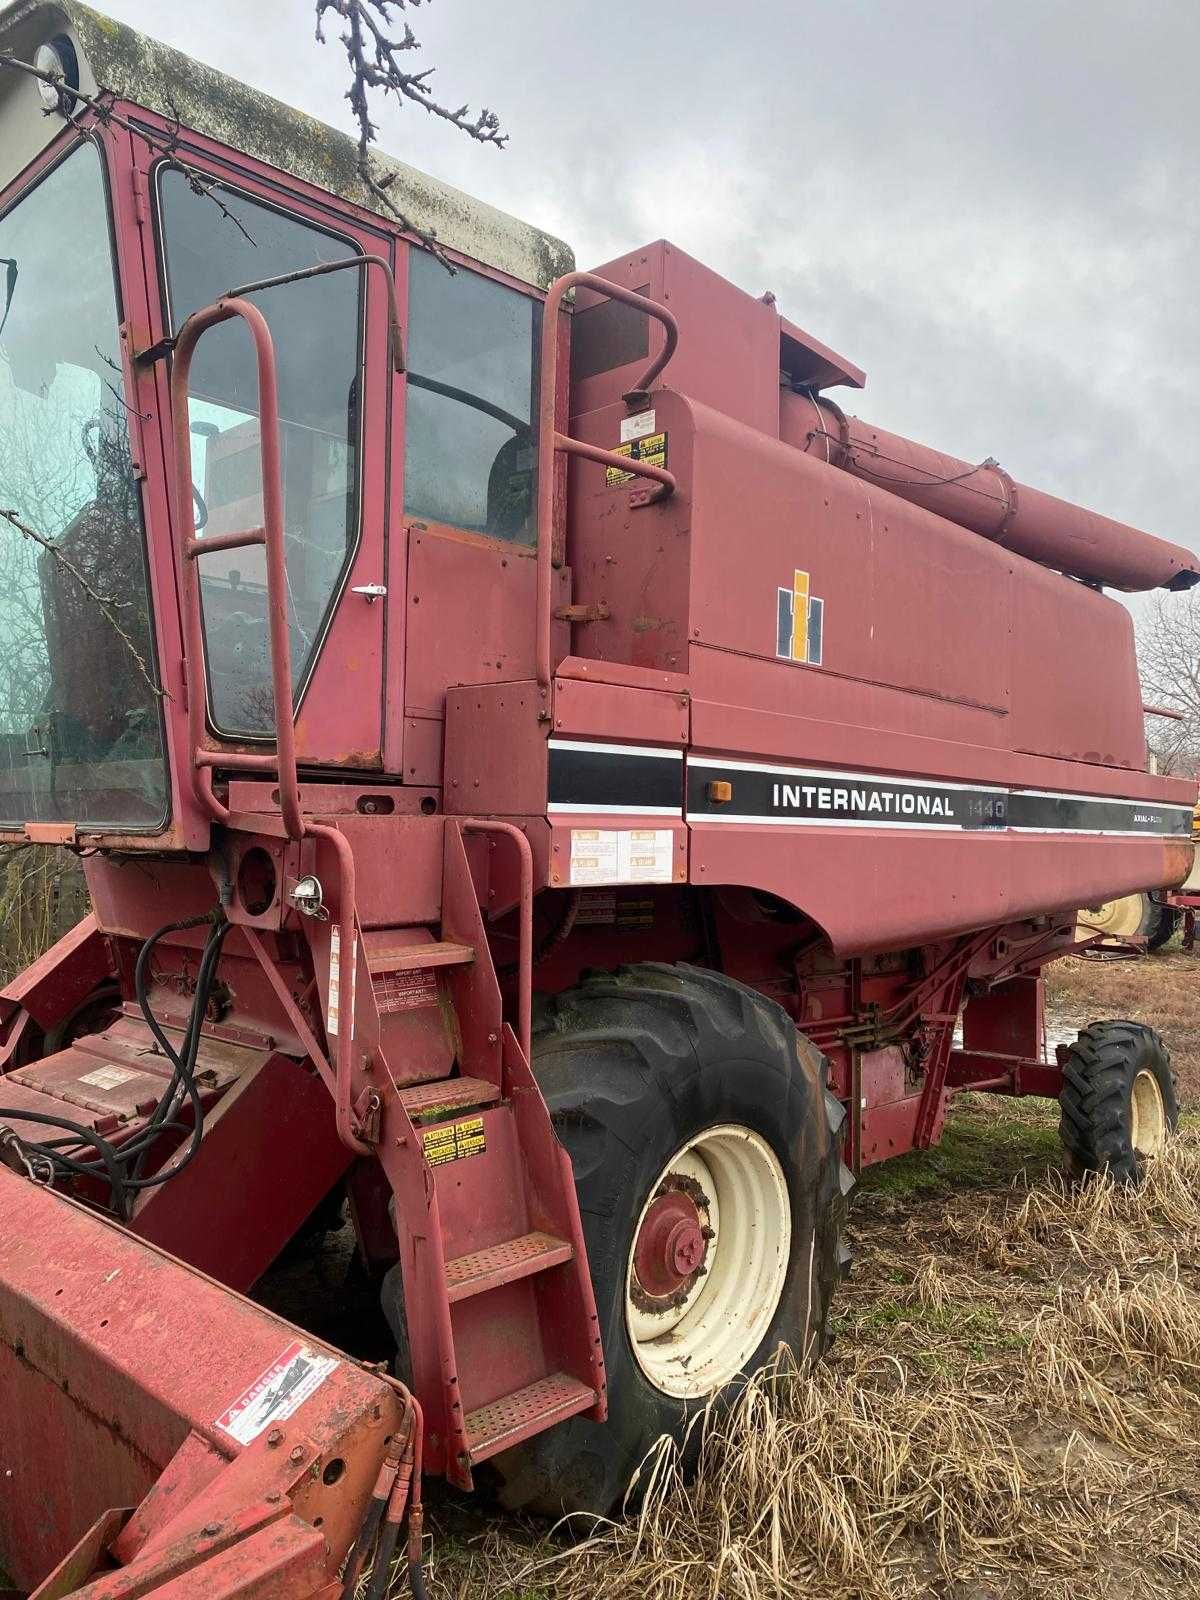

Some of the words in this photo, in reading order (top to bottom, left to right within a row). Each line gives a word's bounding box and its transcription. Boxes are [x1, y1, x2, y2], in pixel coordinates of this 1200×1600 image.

[773, 784, 954, 817] INTERNATIONAL
[968, 799, 1006, 818] 1440
[241, 1364, 284, 1407] DANGER
